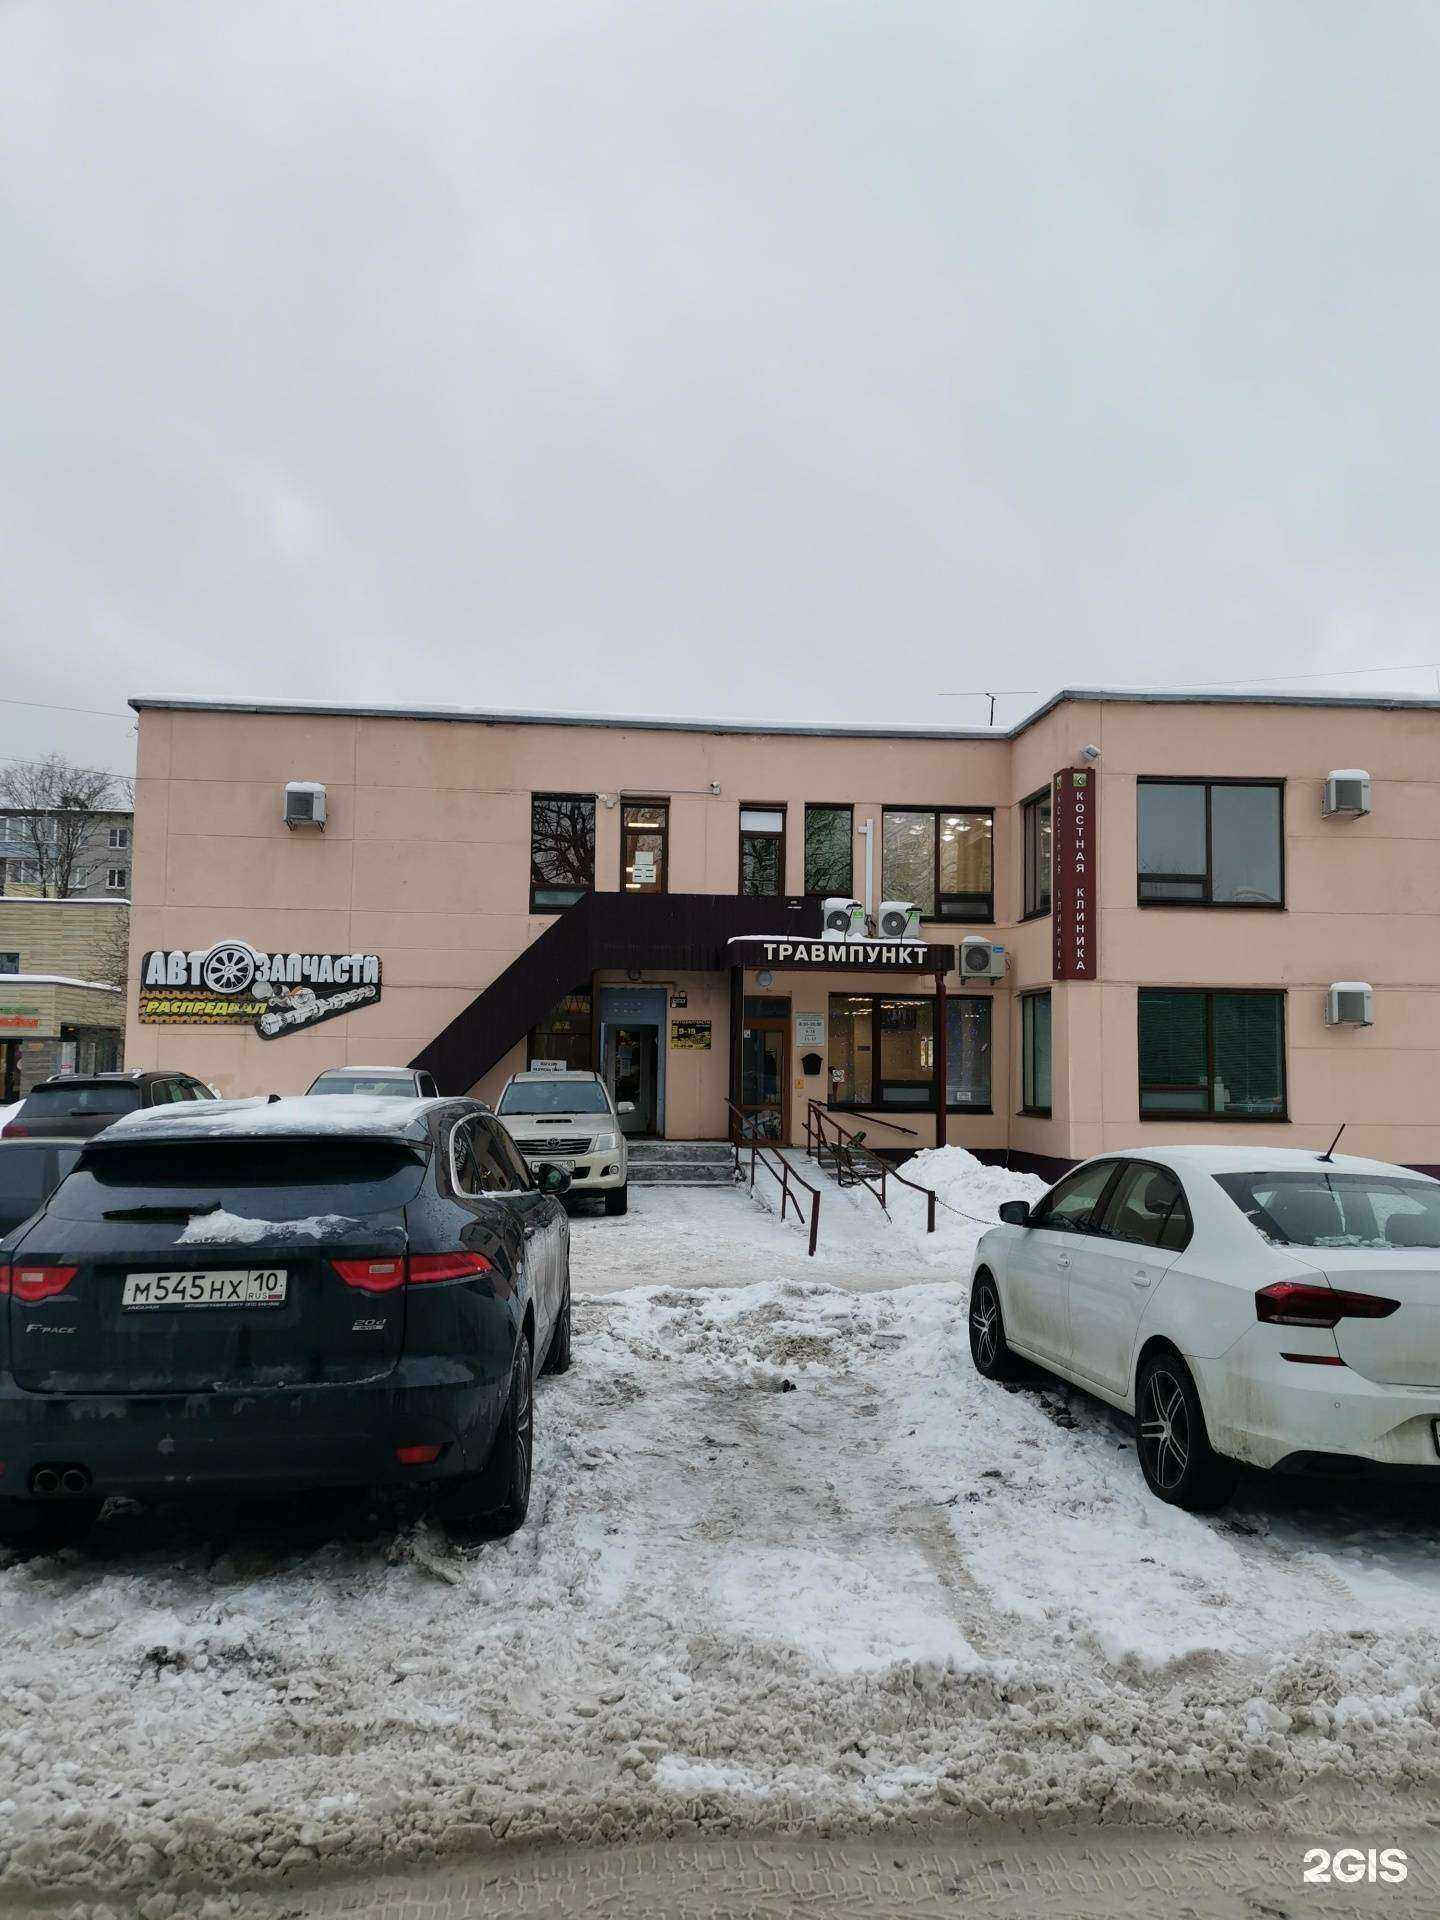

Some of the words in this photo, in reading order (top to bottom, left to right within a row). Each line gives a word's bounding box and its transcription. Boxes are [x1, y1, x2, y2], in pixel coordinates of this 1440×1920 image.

[1075, 791, 1085, 873] КОСТНАЯ
[1075, 888, 1086, 970] КЛИНИКА
[763, 943, 928, 965] ТРАВМПУНКТ
[133, 1275, 243, 1302] М545НХ
[253, 1272, 278, 1292] 10
[248, 1292, 268, 1300] RUS
